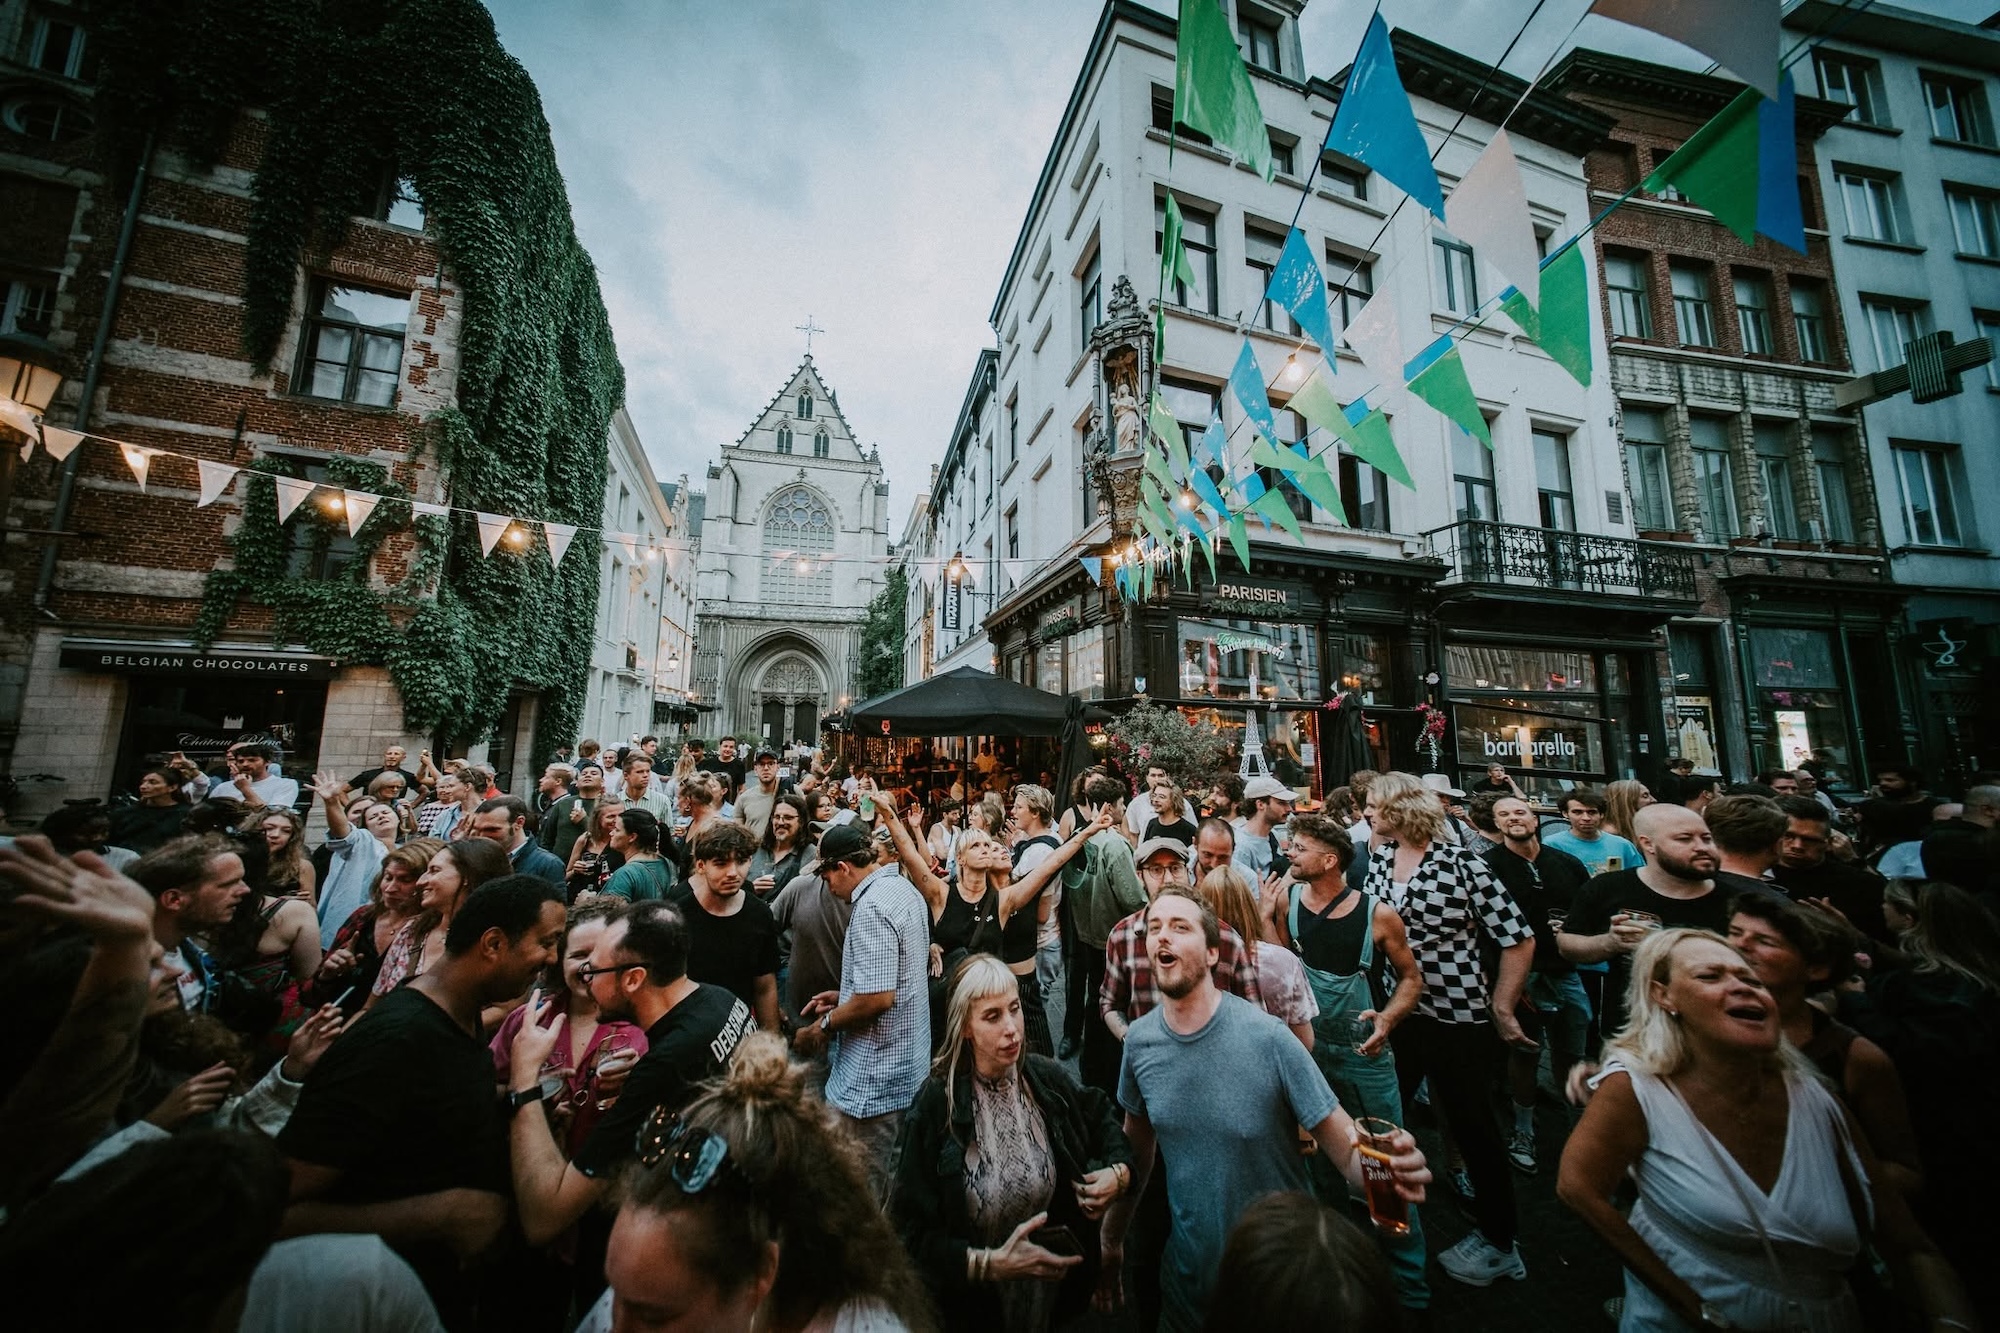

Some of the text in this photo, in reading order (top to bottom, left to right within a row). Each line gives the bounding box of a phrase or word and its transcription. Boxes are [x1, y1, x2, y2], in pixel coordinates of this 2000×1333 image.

[1220, 584, 1287, 604] PARISIEN
[1045, 604, 1073, 627] PARISIEN
[101, 655, 309, 672] BELGIAN CHOCOLATES
[176, 732, 233, 747] Château
[1483, 731, 1576, 757] barbarella
